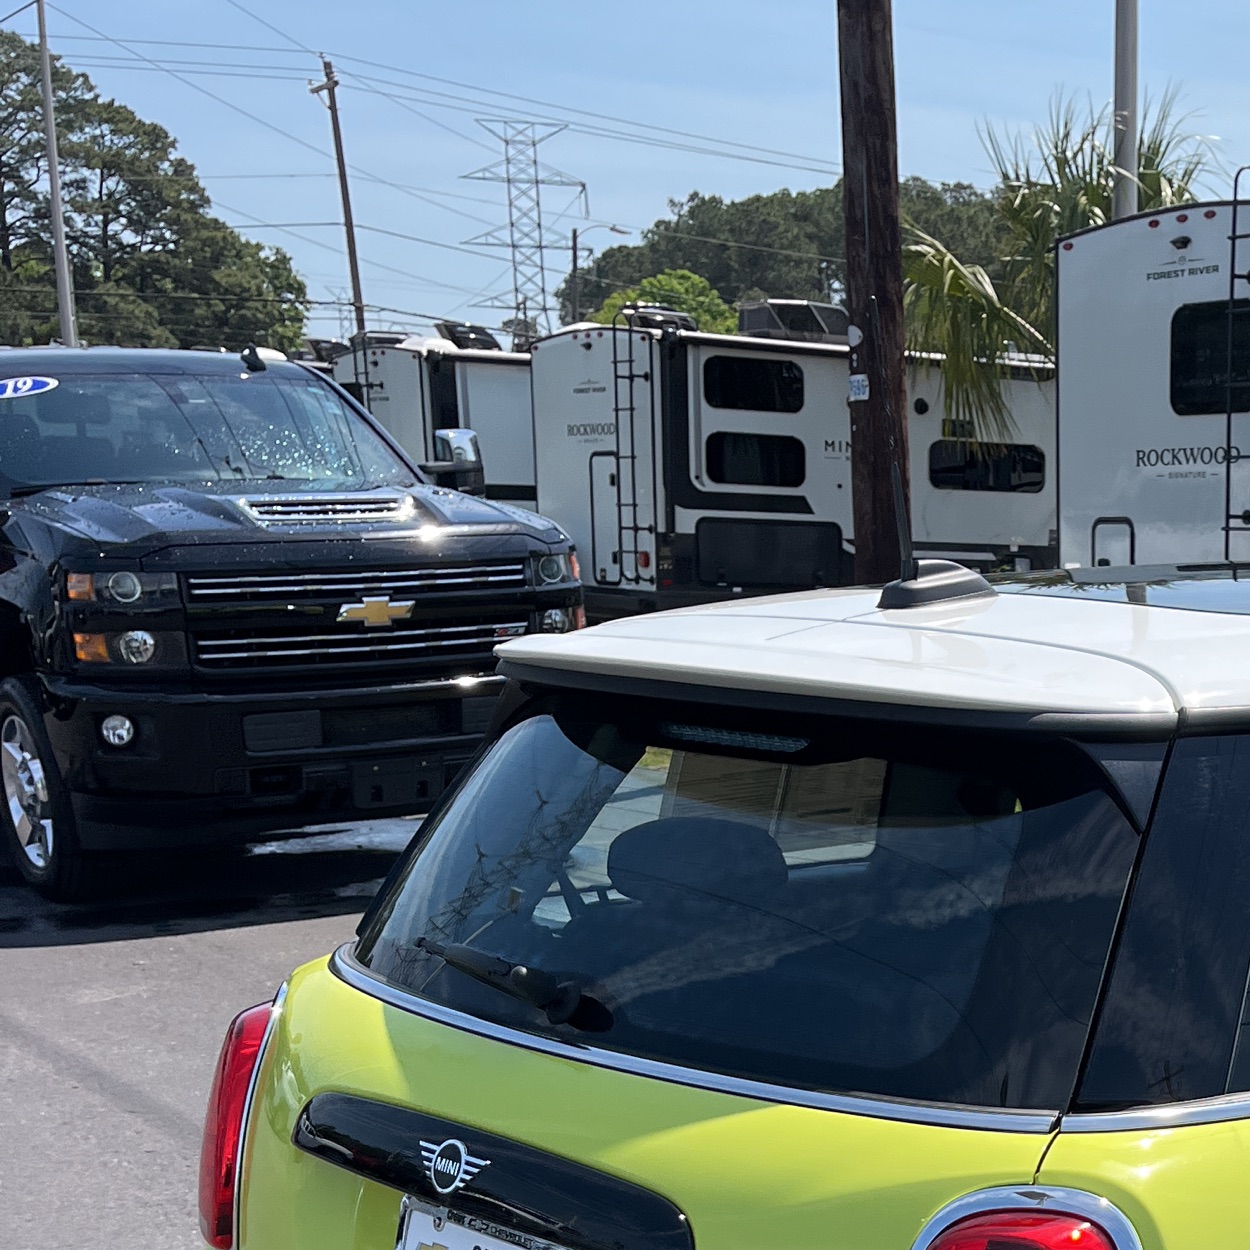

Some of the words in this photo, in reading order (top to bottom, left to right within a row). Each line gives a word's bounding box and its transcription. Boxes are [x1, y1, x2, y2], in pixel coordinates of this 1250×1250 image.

[1146, 269, 1186, 281] FOREST
[1188, 265, 1219, 276] RIVER
[567, 423, 616, 436] ROCKWOOD
[1136, 446, 1241, 467] ROCKWOOD
[435, 1156, 460, 1177] MINI
